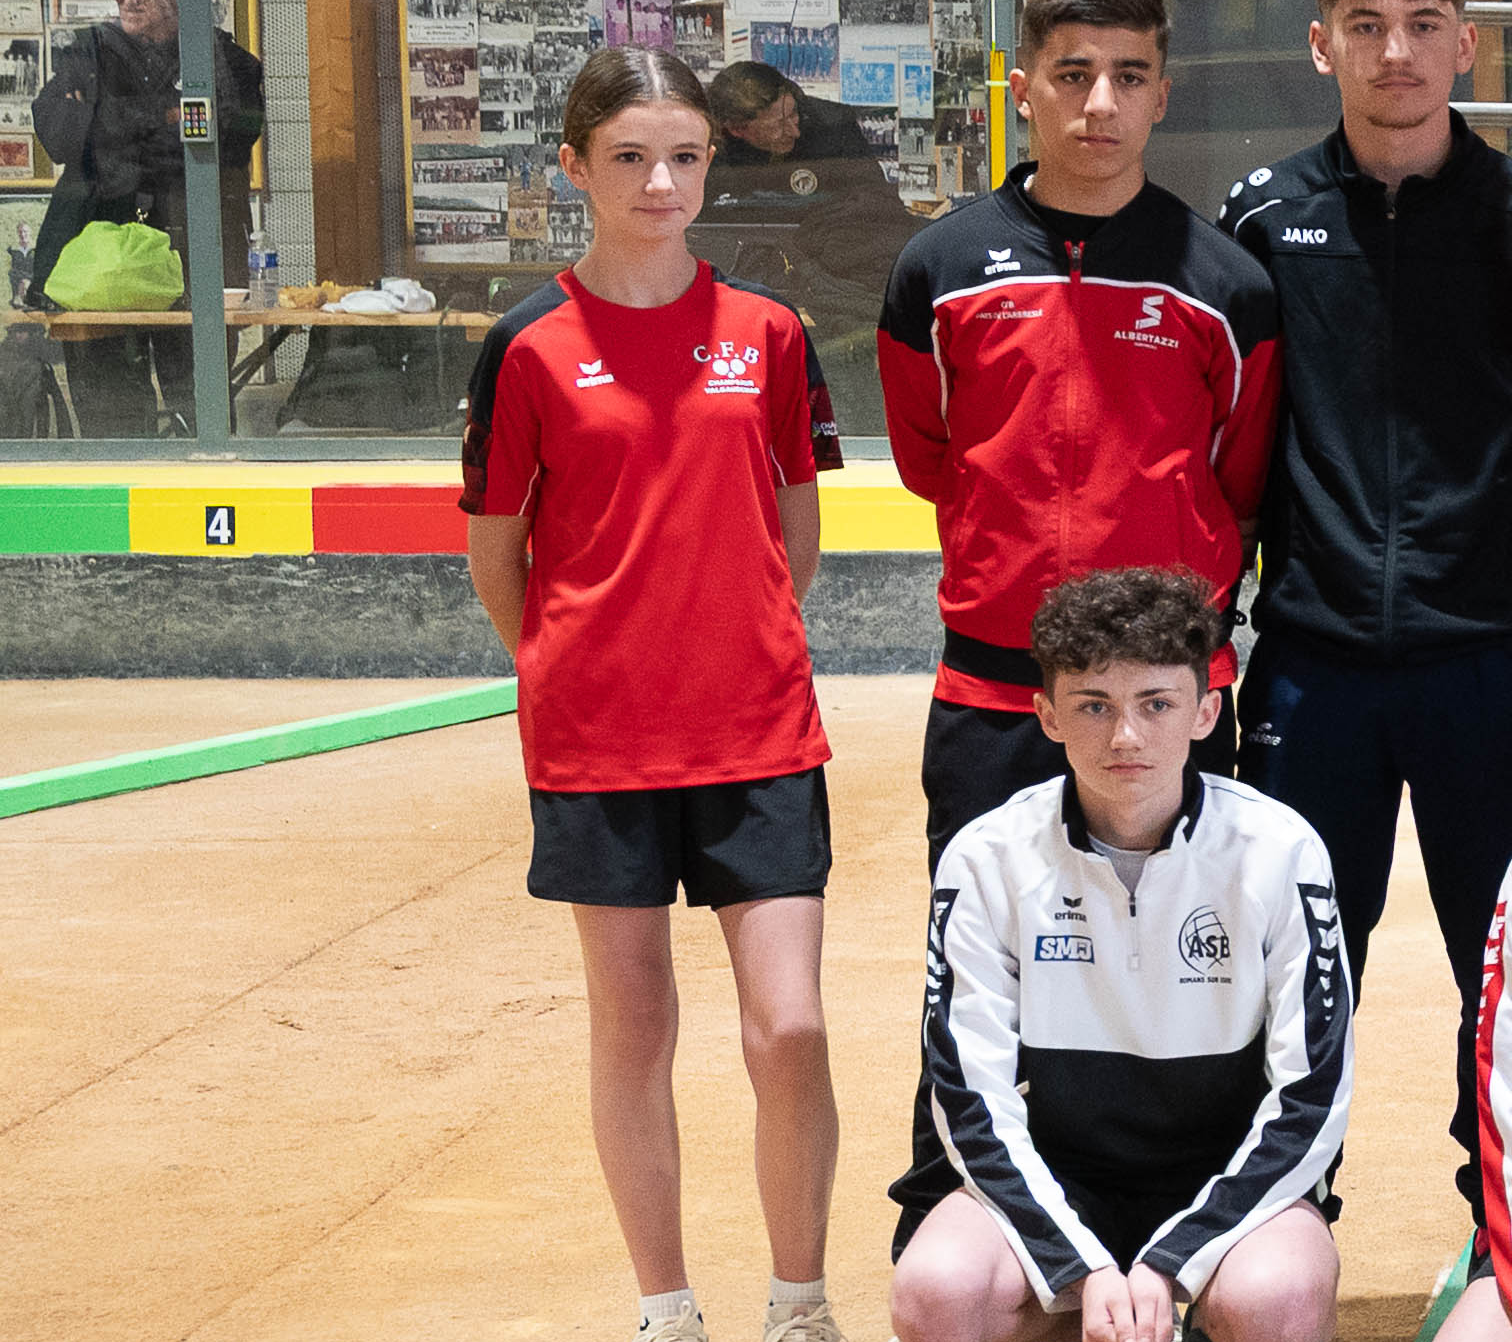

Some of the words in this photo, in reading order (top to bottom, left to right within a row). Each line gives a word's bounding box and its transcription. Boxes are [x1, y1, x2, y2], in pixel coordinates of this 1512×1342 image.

[1282, 227, 1328, 245] JAKO
[1114, 330, 1179, 349] ALBERTAZZI
[208, 508, 231, 544] 4
[1189, 935, 1230, 958] ASB
